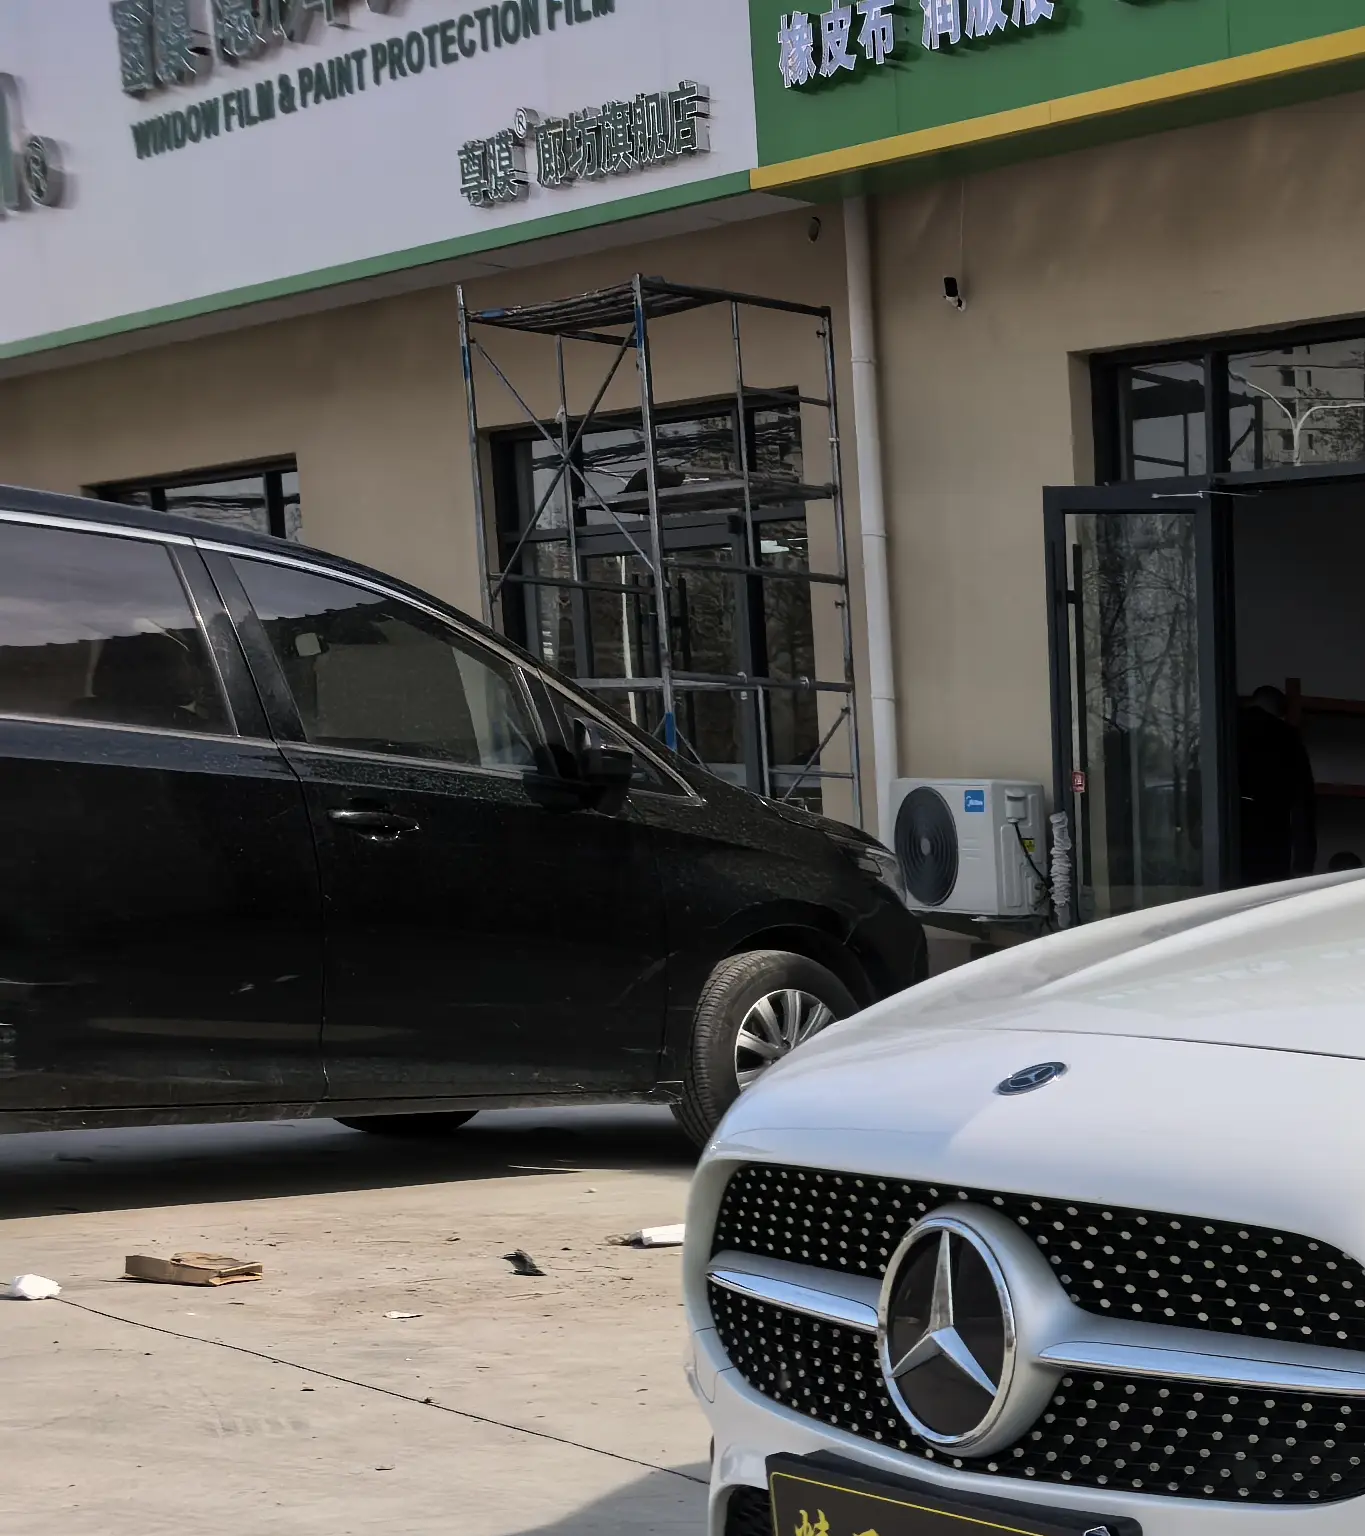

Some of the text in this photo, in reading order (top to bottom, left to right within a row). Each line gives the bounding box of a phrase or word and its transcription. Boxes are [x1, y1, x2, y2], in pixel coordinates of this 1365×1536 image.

[130, 97, 221, 160] WINDOW
[223, 80, 276, 133] FILM
[278, 73, 298, 115] &
[298, 48, 368, 108] PAINT
[372, 0, 541, 86] PROTECTION
[778, 0, 895, 88] 橡皮布
